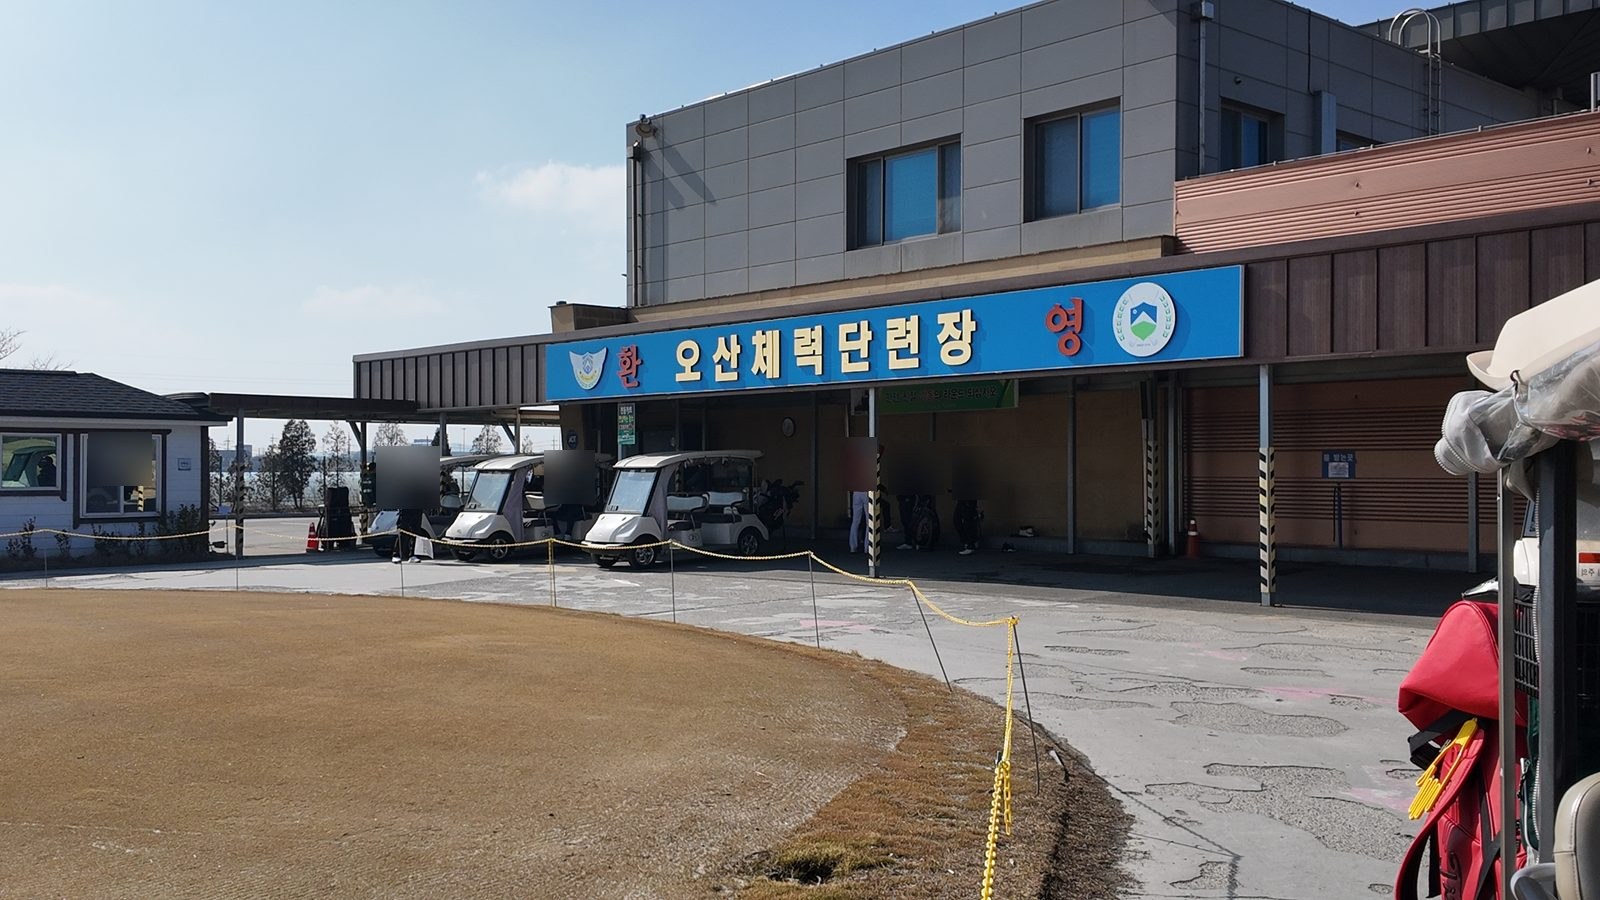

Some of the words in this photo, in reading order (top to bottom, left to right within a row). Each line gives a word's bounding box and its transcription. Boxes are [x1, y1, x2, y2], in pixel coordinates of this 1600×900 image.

[616, 344, 641, 388] 환
[675, 309, 977, 382] 오산체력단련장
[1044, 297, 1083, 357] 영
